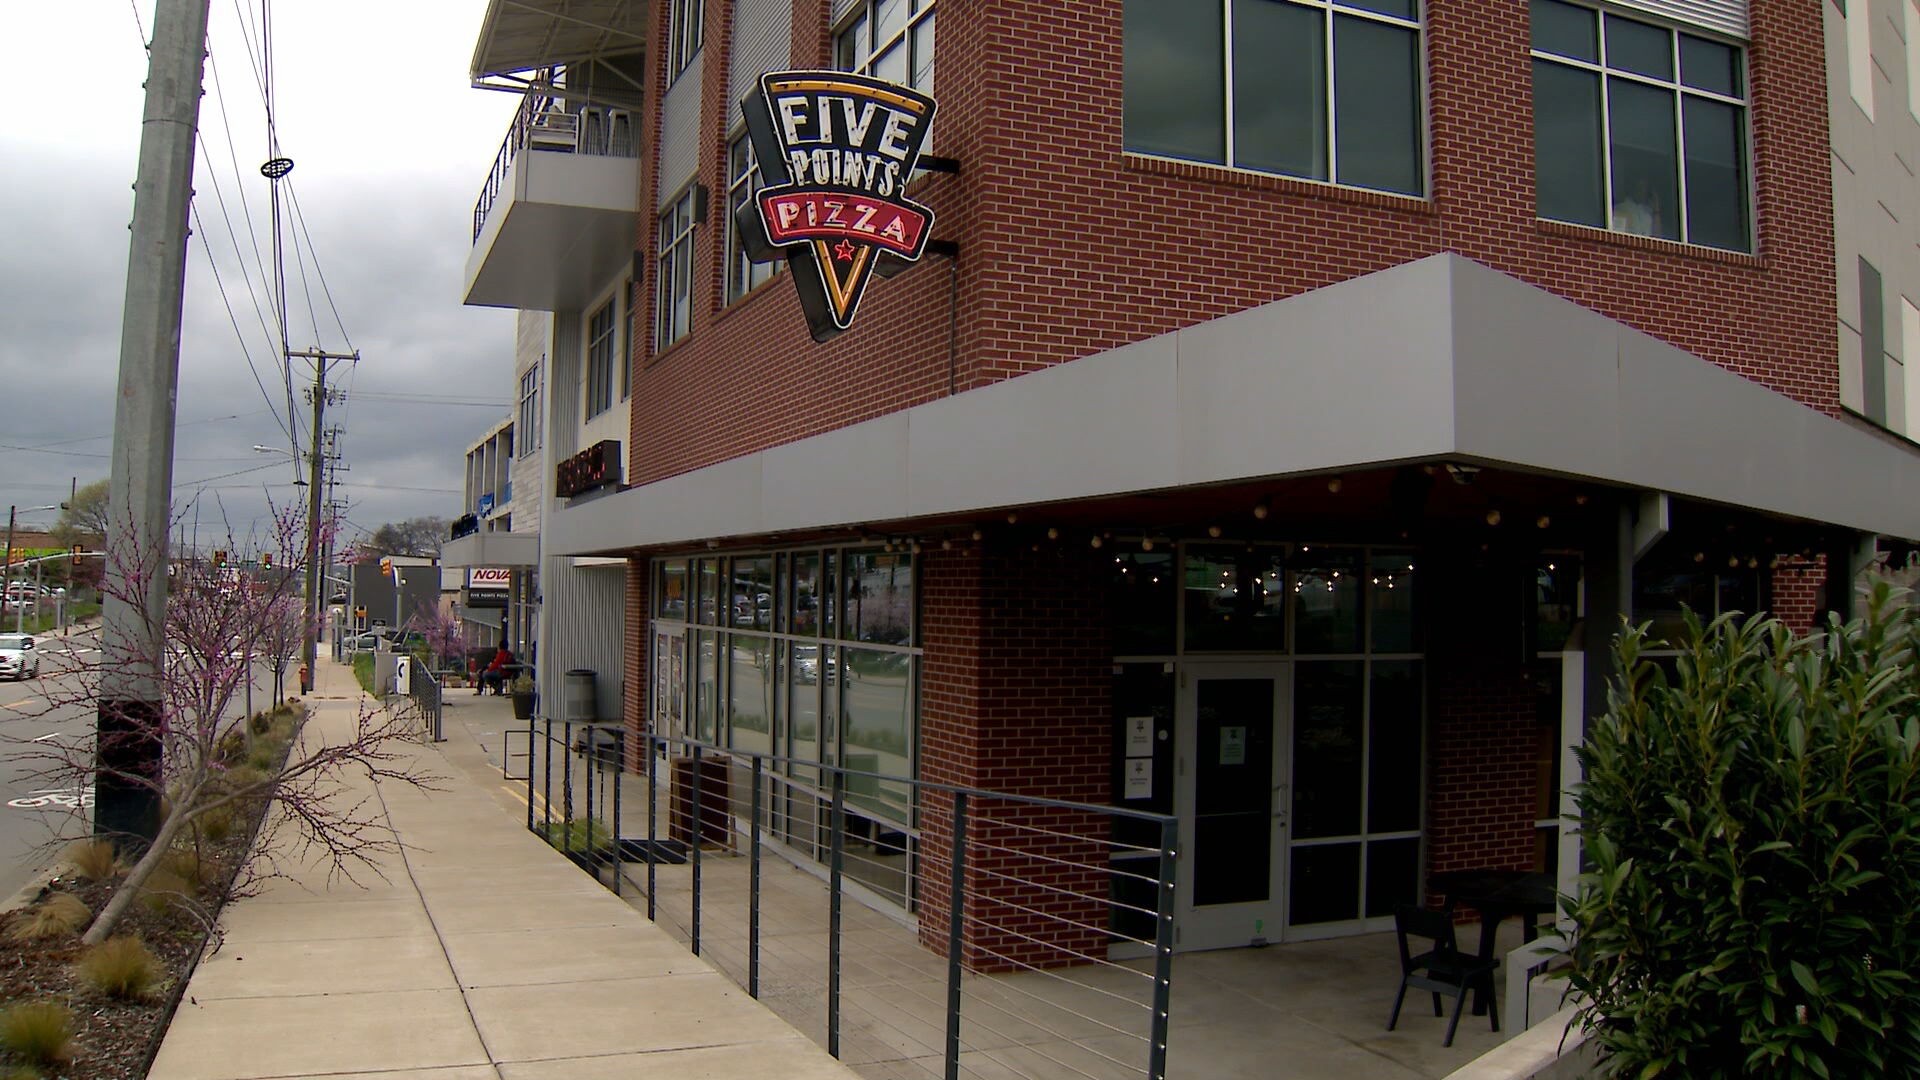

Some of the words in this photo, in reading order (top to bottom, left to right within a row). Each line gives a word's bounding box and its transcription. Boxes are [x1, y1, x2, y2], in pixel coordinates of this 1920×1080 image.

[777, 96, 917, 161] FIVE
[790, 148, 900, 197] POINTS
[777, 201, 905, 243] PIZZA
[473, 570, 511, 580] NOVA
